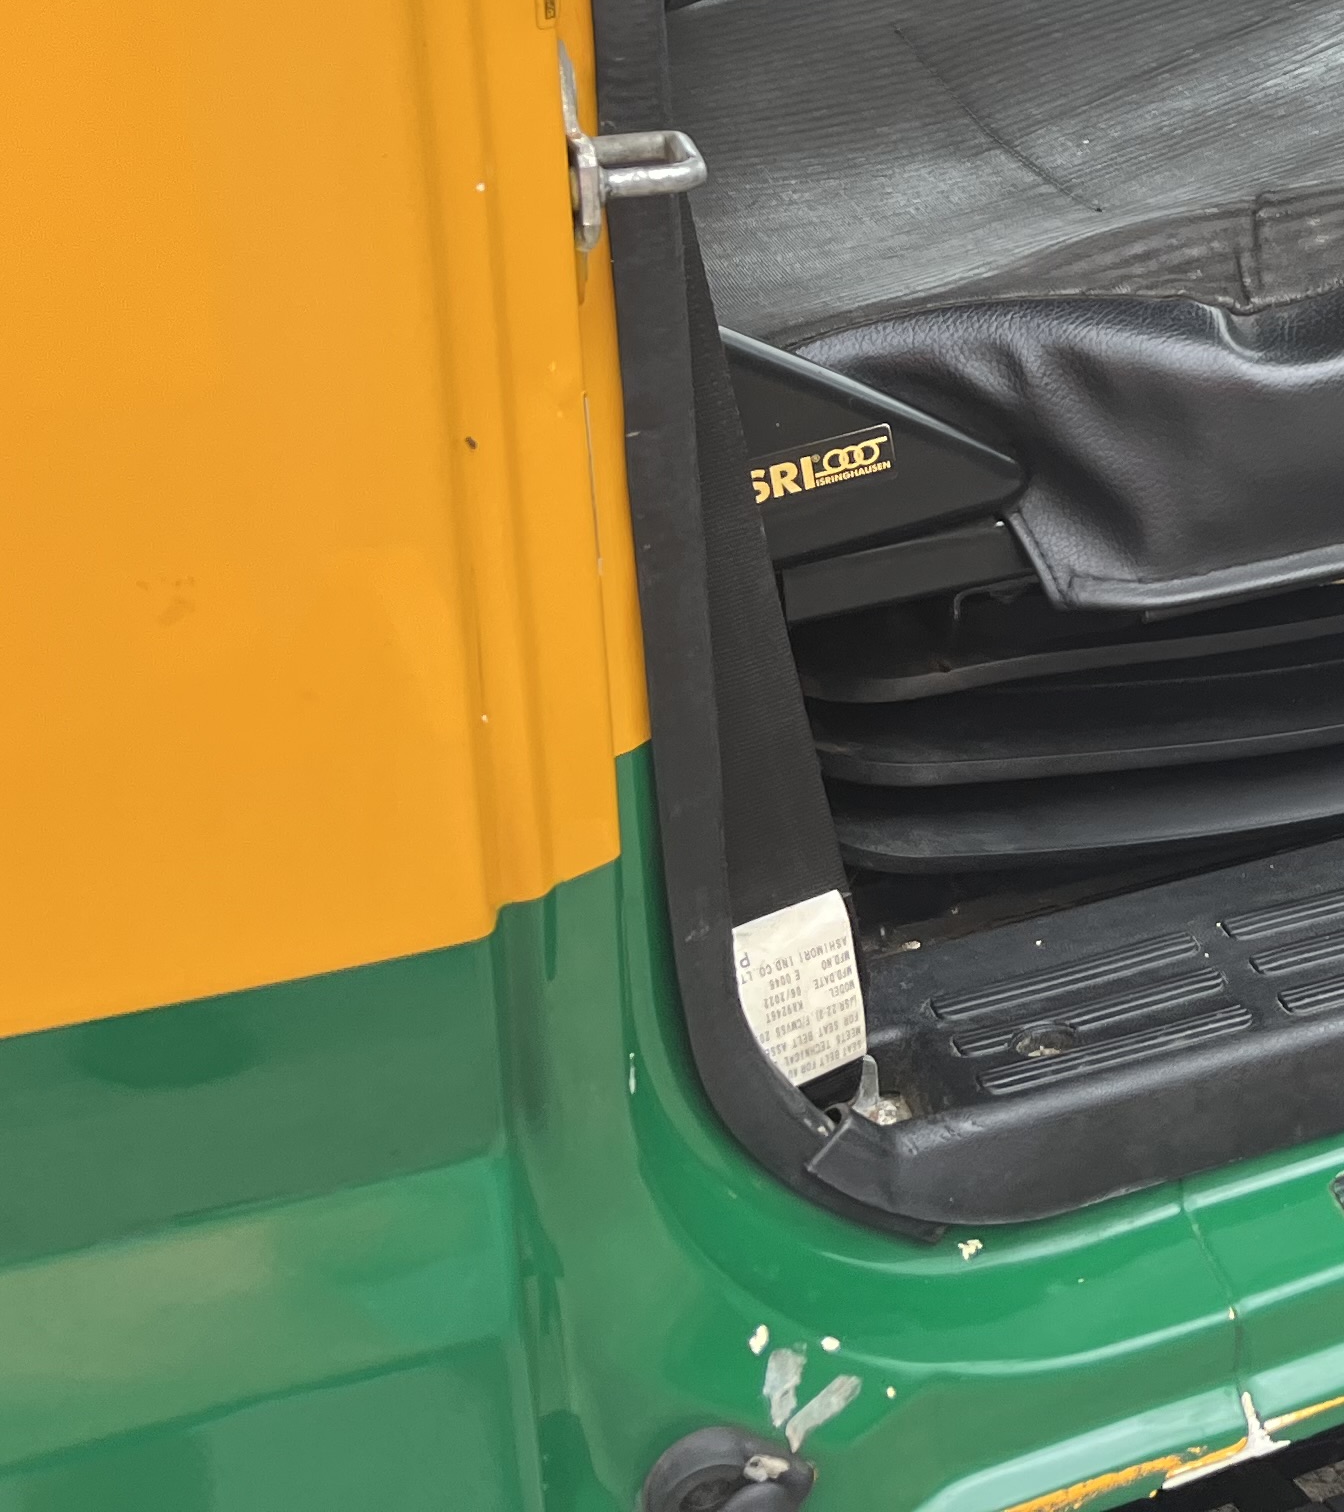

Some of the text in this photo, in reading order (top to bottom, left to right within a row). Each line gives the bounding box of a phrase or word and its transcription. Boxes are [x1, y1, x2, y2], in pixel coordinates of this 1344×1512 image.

[815, 460, 892, 487] ISRINGHAUSEN
[799, 936, 848, 963] ASHIMORI
[740, 952, 751, 968] P
[829, 979, 855, 997] MODEL
[763, 986, 802, 1009] 06/2022
[844, 1012, 859, 1026] FOR
[819, 1021, 838, 1038] SEAT
[784, 1027, 861, 1066] MEETS TECHNICAL
[792, 1031, 813, 1049] BELT
[843, 1040, 861, 1057] SEAT
[819, 1050, 840, 1067] BELT
[801, 1061, 816, 1074] FOR
